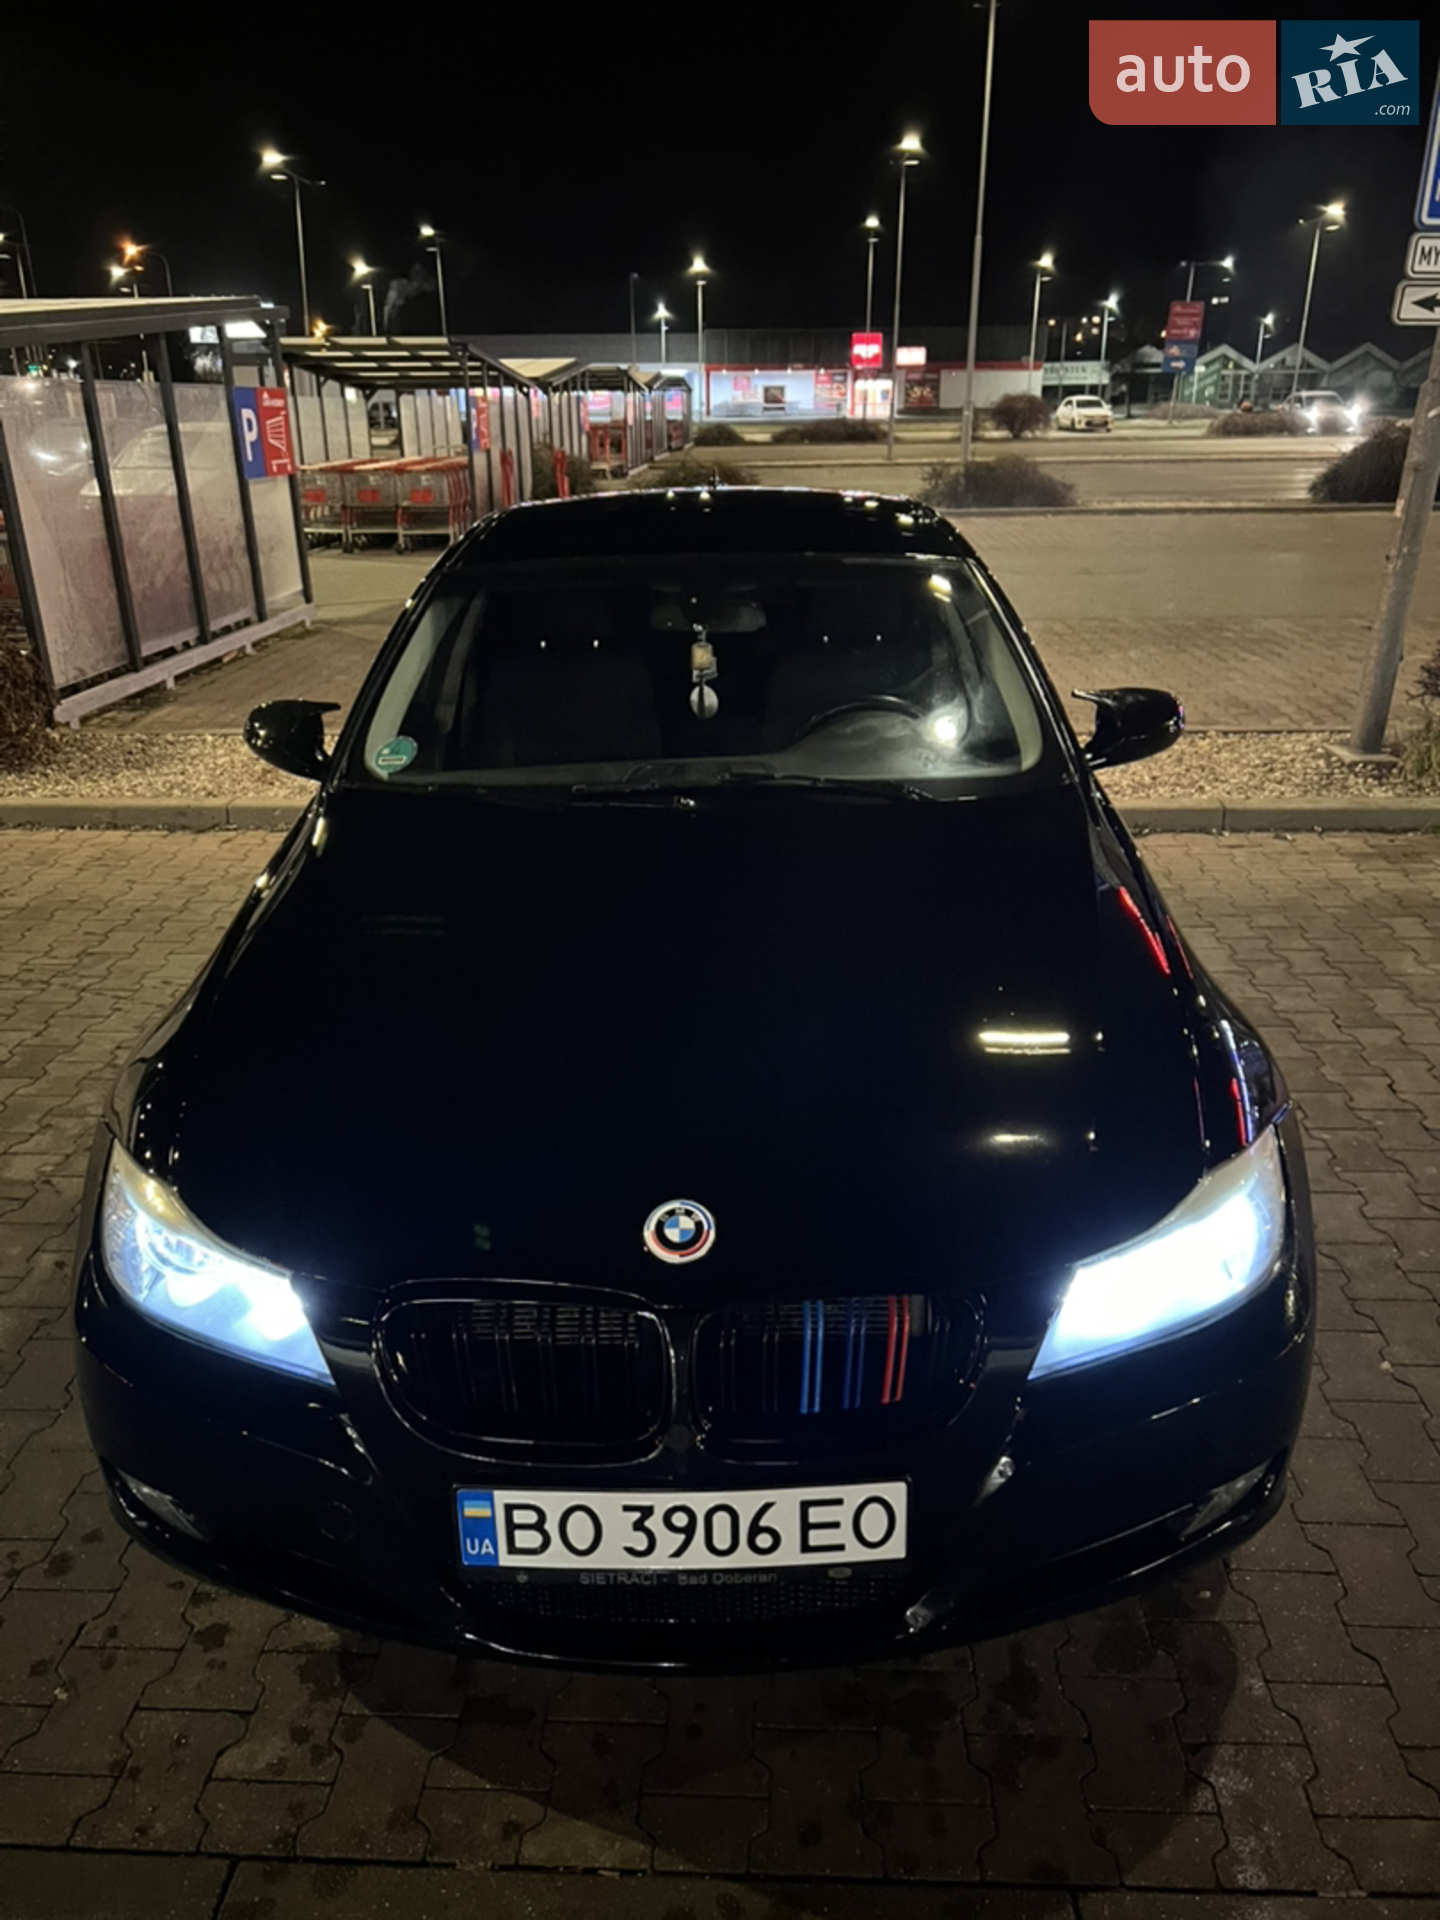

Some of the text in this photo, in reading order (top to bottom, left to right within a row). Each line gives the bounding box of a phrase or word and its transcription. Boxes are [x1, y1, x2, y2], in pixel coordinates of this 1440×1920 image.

[241, 408, 258, 462] P
[465, 1538, 496, 1558] UA
[503, 1495, 897, 1558] BO 3906 EO
